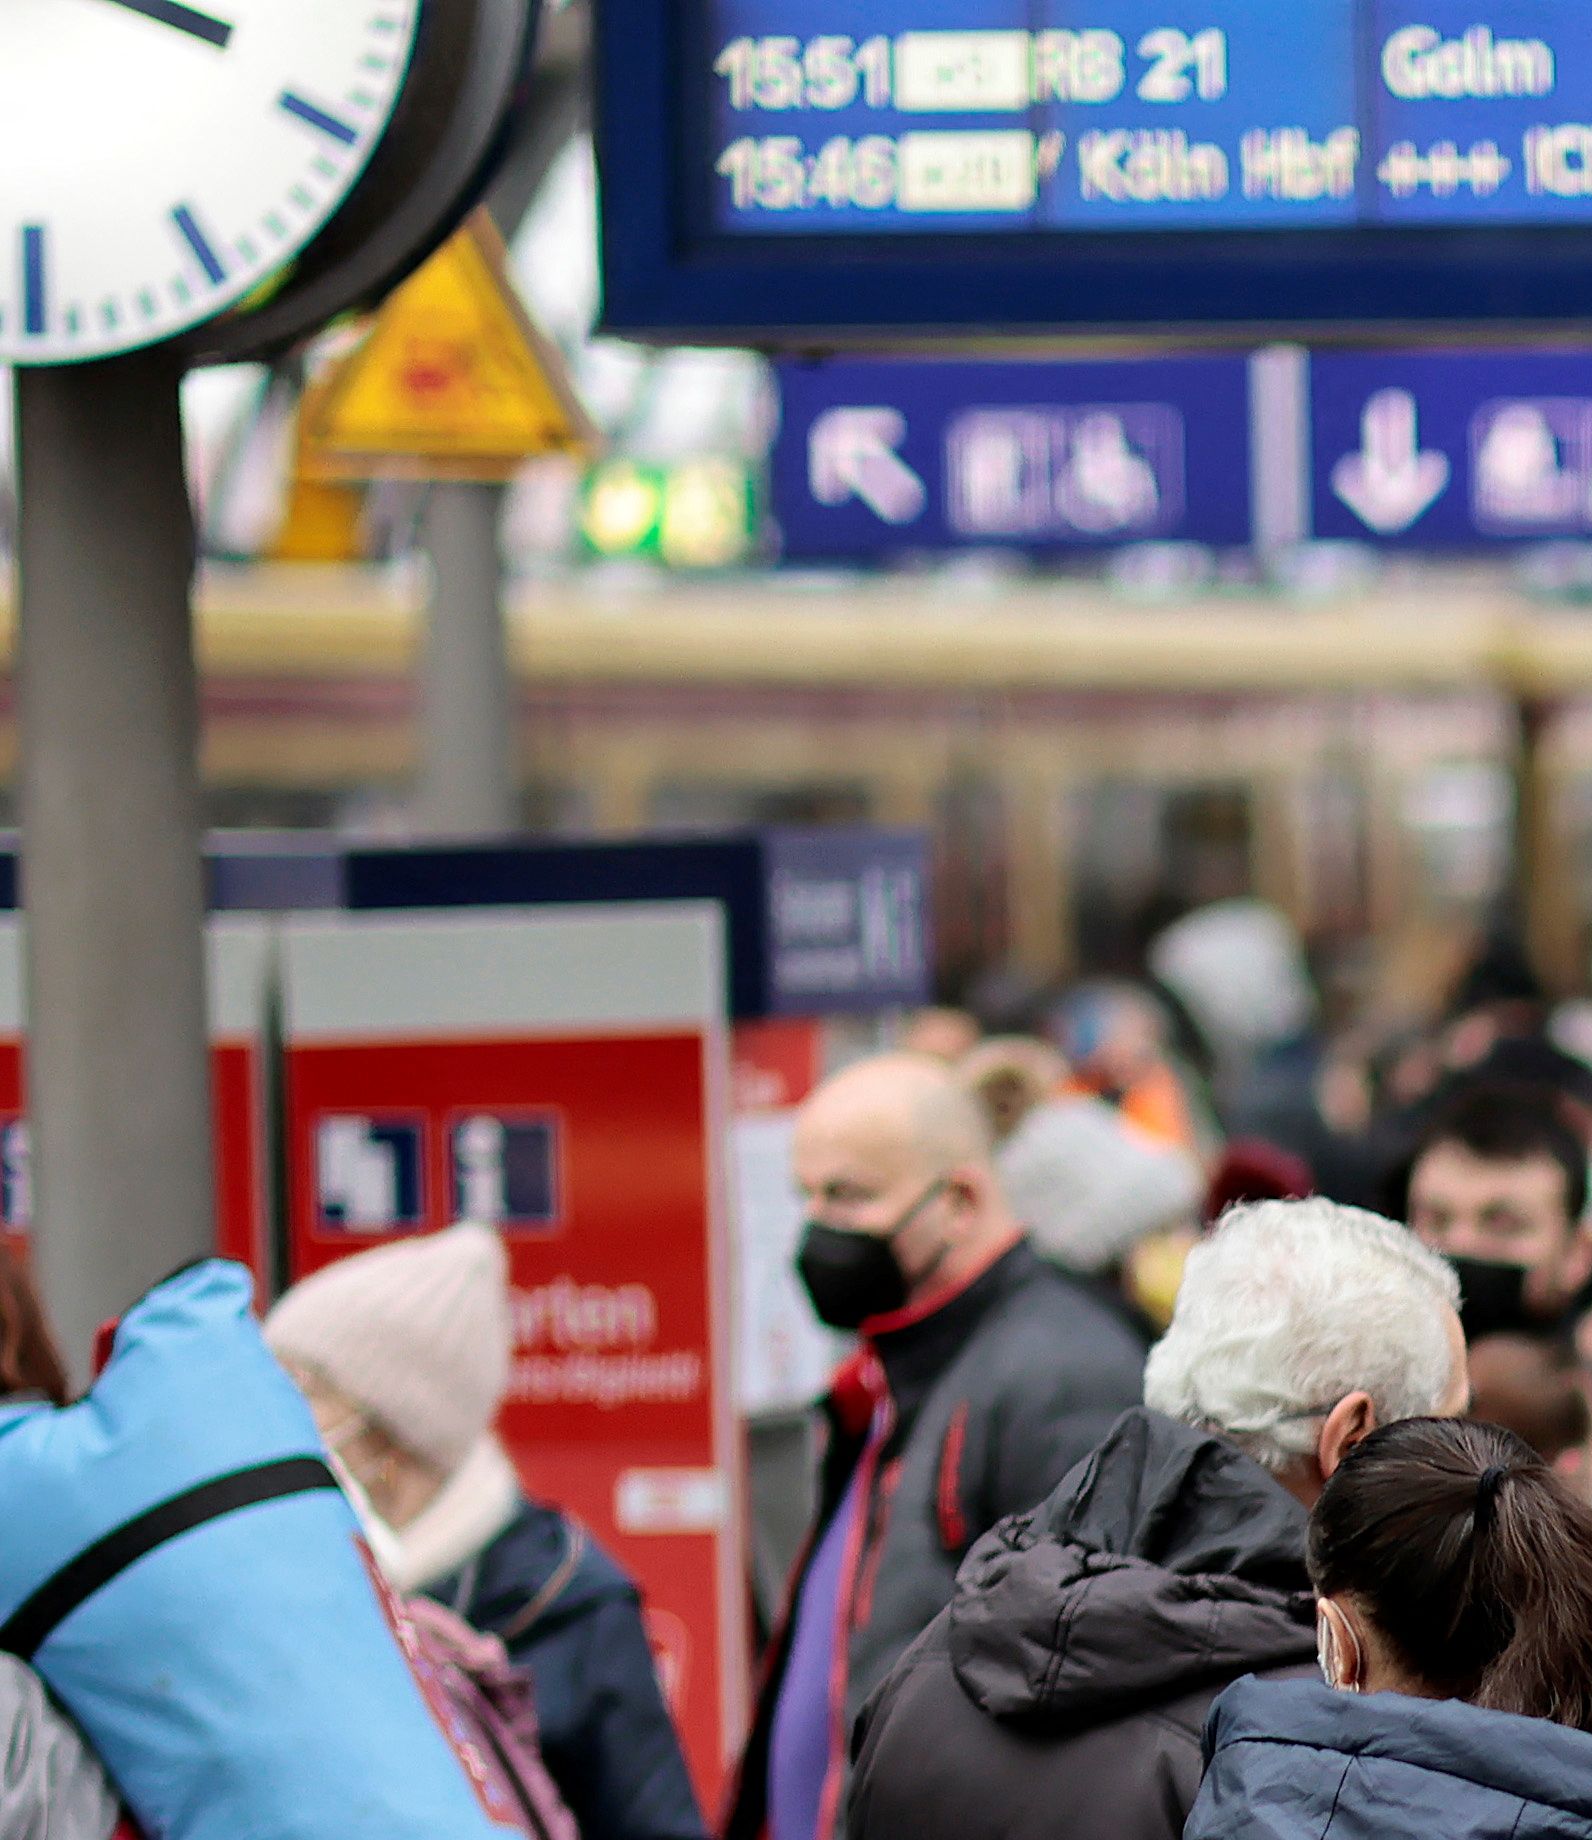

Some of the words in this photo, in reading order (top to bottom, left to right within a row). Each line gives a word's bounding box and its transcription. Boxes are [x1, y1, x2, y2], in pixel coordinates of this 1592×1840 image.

[1036, 28, 1124, 103] RB
[1136, 28, 1228, 102] 21
[714, 135, 898, 211] 15:46
[1078, 127, 1230, 202] Köln
[1240, 124, 1360, 201] Hbf
